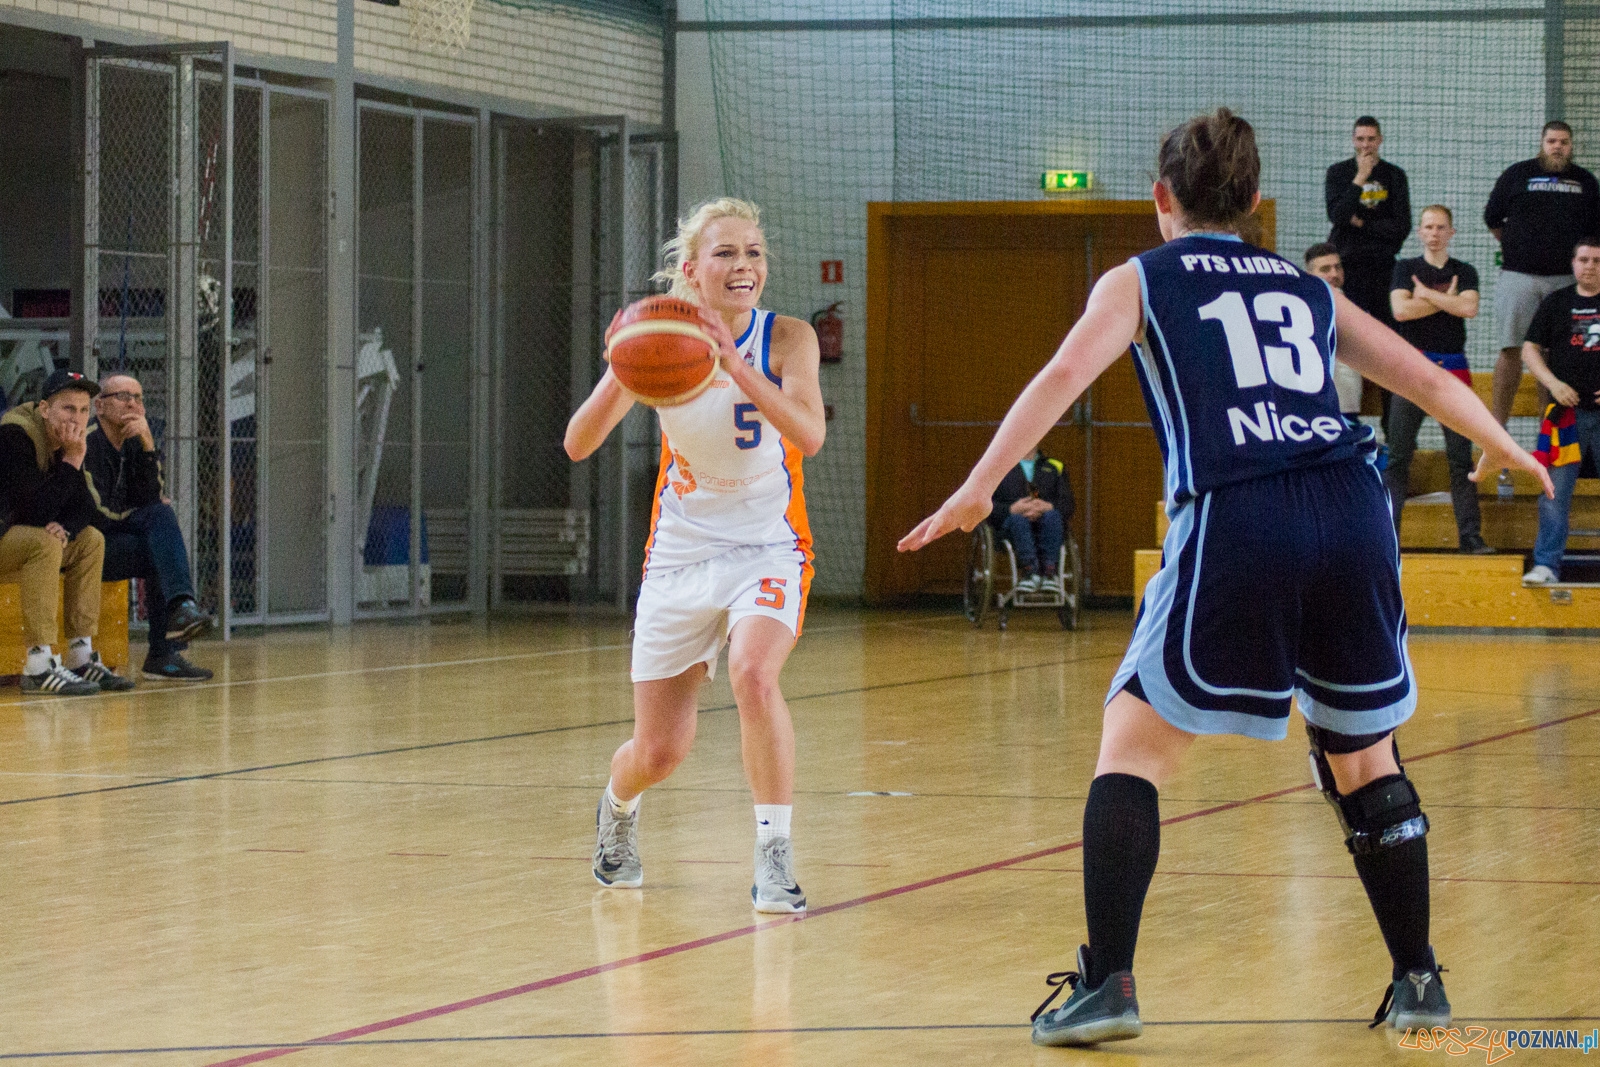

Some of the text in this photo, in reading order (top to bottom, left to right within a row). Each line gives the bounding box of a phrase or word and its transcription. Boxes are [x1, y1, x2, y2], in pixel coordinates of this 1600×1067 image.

[1180, 254, 1300, 277] PTS LIDER
[1198, 291, 1324, 393] 13
[734, 403, 761, 449] 5
[1227, 401, 1342, 445] Nice
[755, 577, 787, 610] 5
